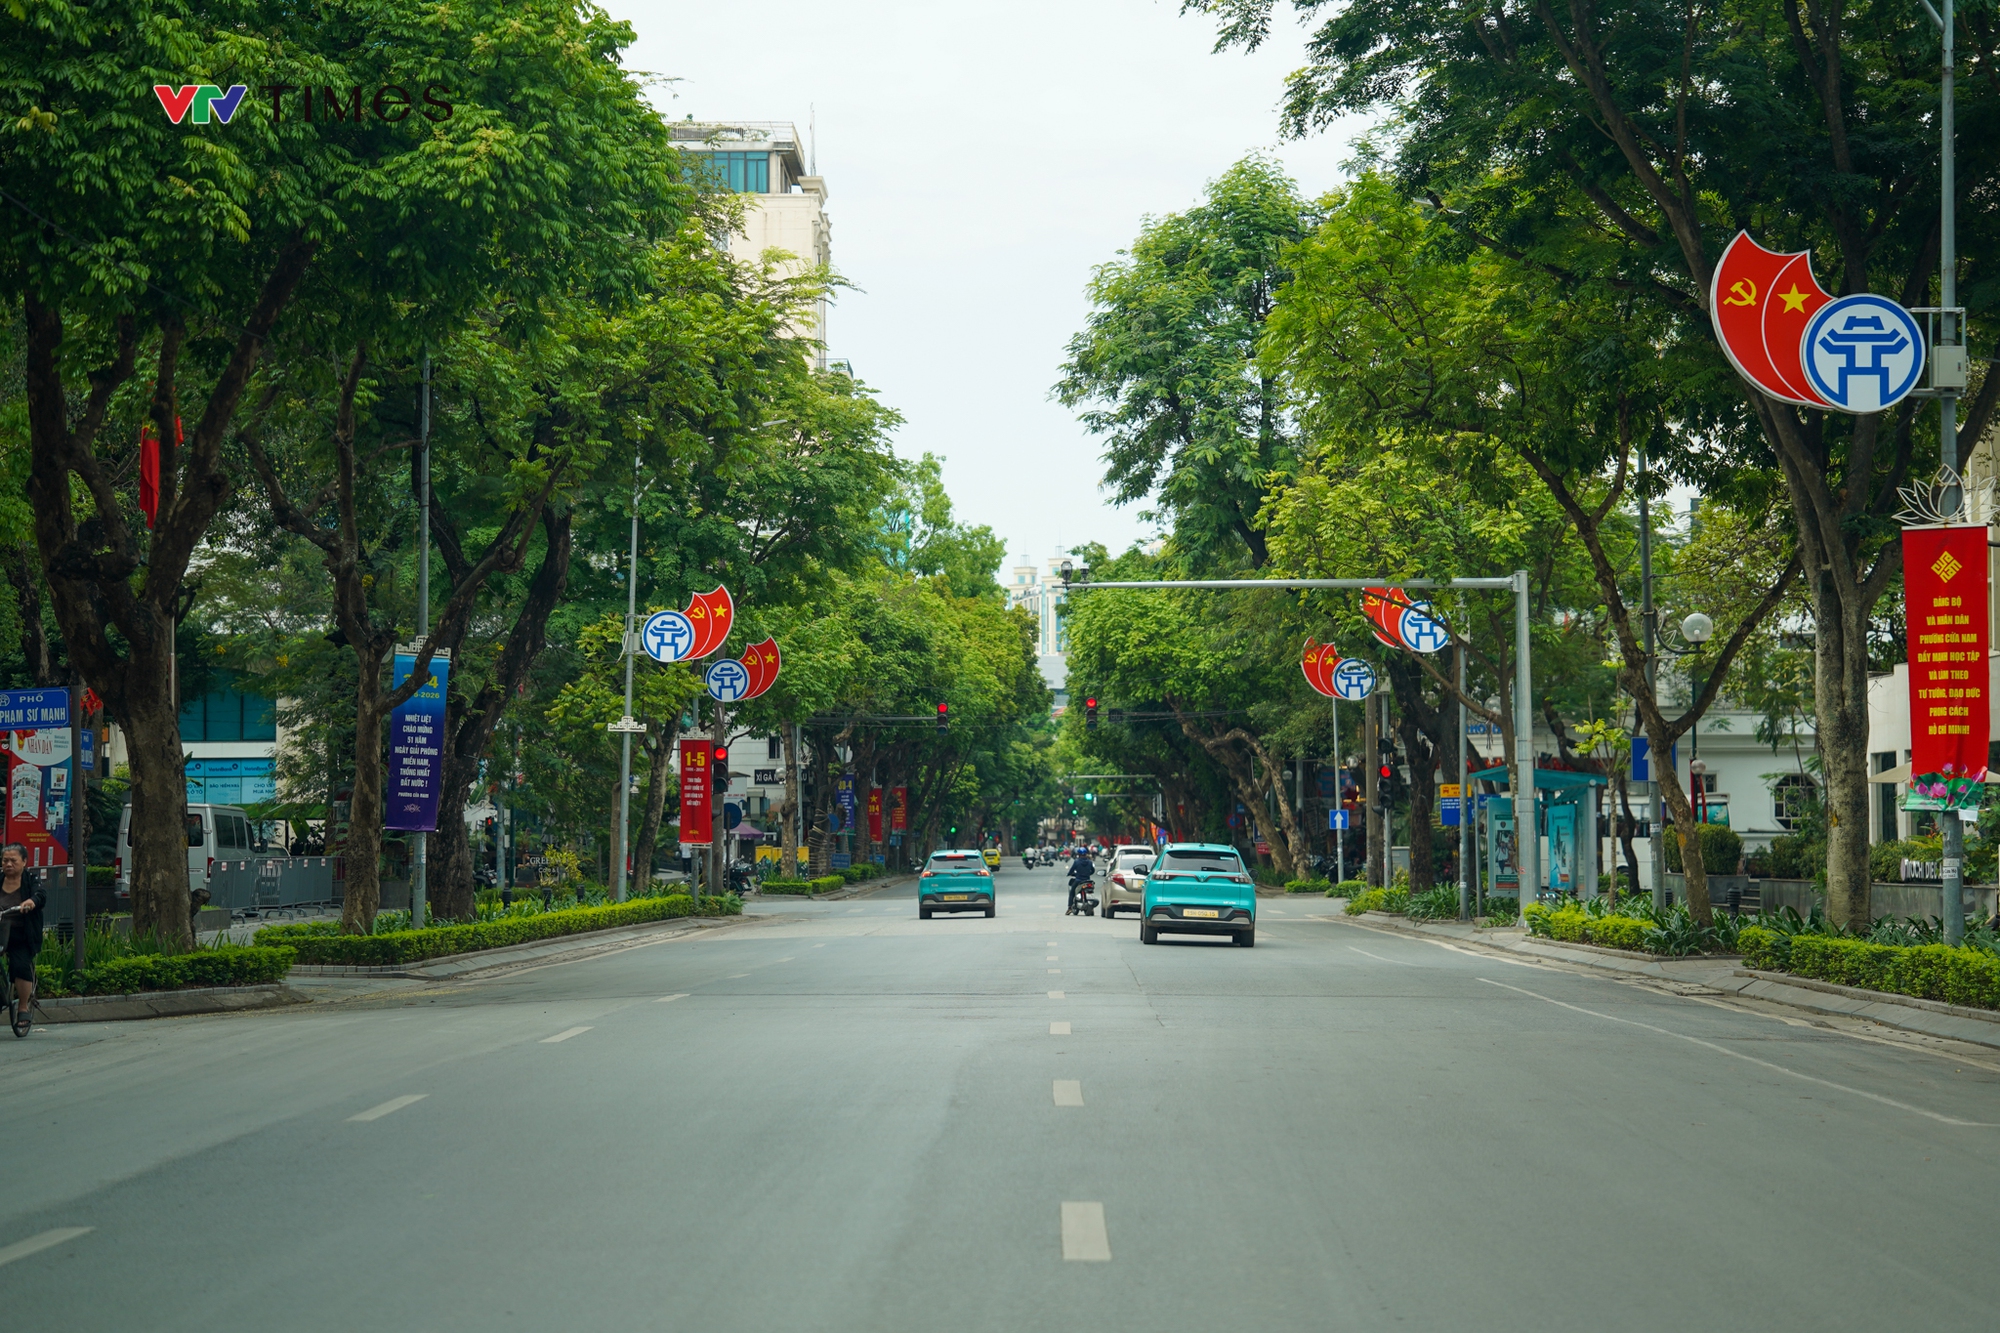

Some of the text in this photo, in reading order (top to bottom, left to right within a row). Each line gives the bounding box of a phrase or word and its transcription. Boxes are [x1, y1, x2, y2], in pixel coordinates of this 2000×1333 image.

[1933, 595, 1962, 608] ĐẢNG BỘ
[1926, 614, 1970, 626] VÀ NHÂN DÂN
[1920, 632, 1977, 644] PHƯỜNG CỬA NAM
[1932, 652, 1948, 663] MẠNH
[1950, 652, 1965, 663] HỌC
[1966, 650, 1980, 662] TẬP
[1928, 669, 1969, 680] VÀ LÀM THEO
[19, 691, 44, 703] PHỐ
[1918, 688, 1928, 699] TƯ
[1949, 688, 1964, 699] ĐẠO
[1965, 687, 1981, 698] ĐỨC
[0, 707, 66, 726] PHẠM SƯ MẠNH
[1929, 705, 1969, 717] PHONG CÁCH
[405, 714, 432, 724] NHIỆT LIỆT
[402, 724, 417, 733] CHÀO
[1928, 723, 1970, 735] HỒ CHÍ MINH!
[394, 745, 409, 754] NGÀY
[685, 751, 705, 767] 1-5
[400, 766, 430, 777] THỐNG NHẤT
[400, 777, 410, 786] ĐẤT
